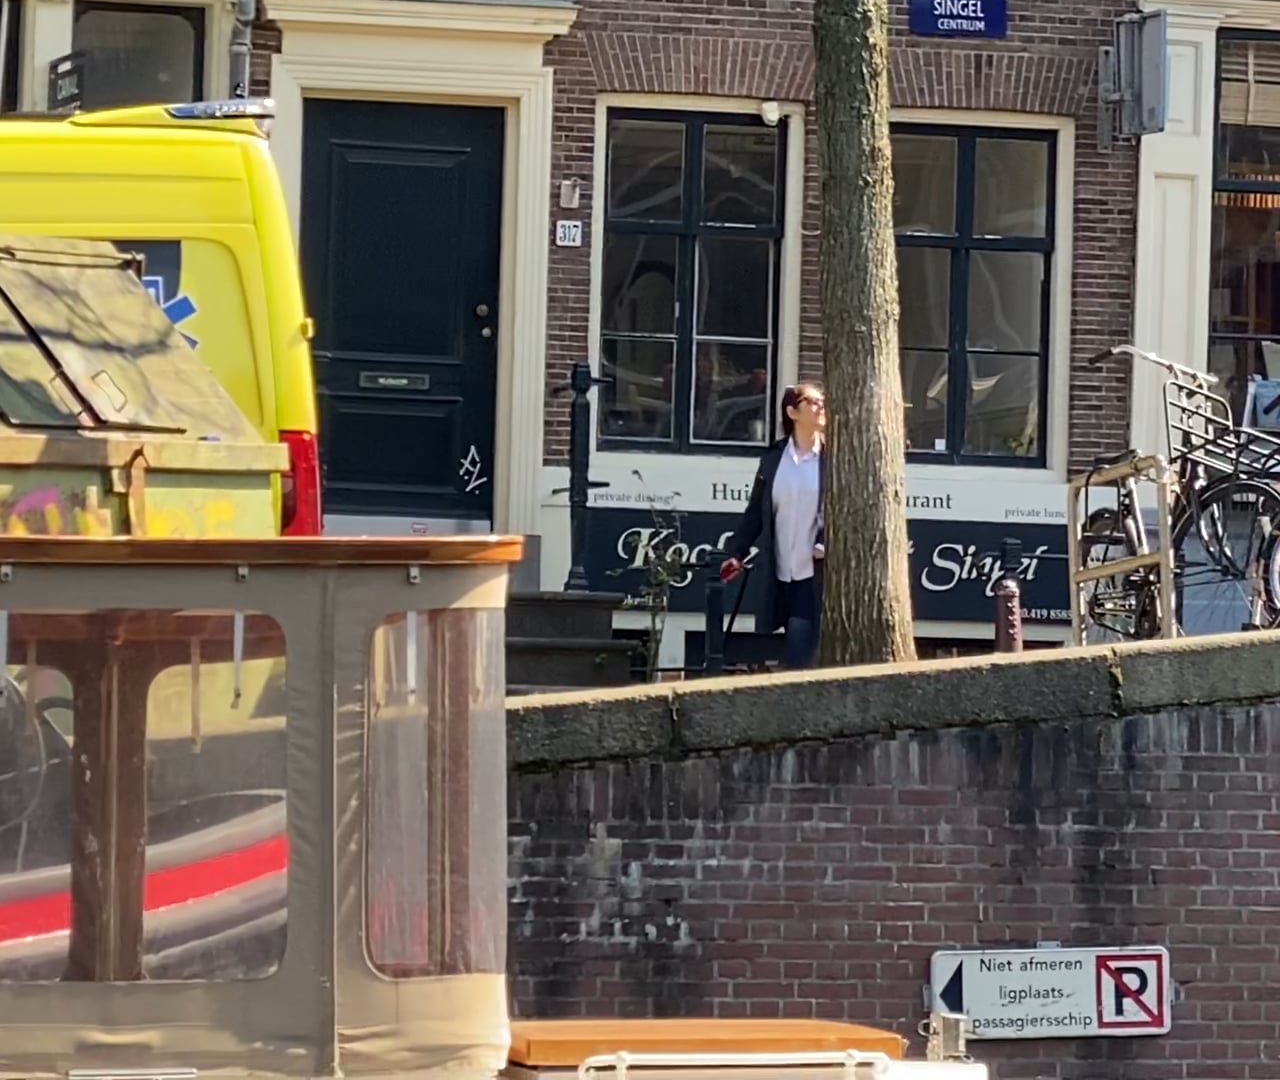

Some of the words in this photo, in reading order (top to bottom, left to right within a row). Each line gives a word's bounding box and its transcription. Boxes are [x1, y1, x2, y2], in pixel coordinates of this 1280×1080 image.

[937, 18, 986, 32] CENTRUM
[558, 223, 580, 243] 317
[593, 492, 633, 504] private
[711, 482, 752, 502] Hui
[905, 493, 953, 510] urant
[1004, 508, 1042, 520] private
[1043, 509, 1067, 519] lunc
[979, 957, 1014, 972] Niet
[1019, 956, 1083, 971] afmeren
[998, 985, 1065, 1004] ligplaats
[972, 1012, 1094, 1033] passagiersschip
